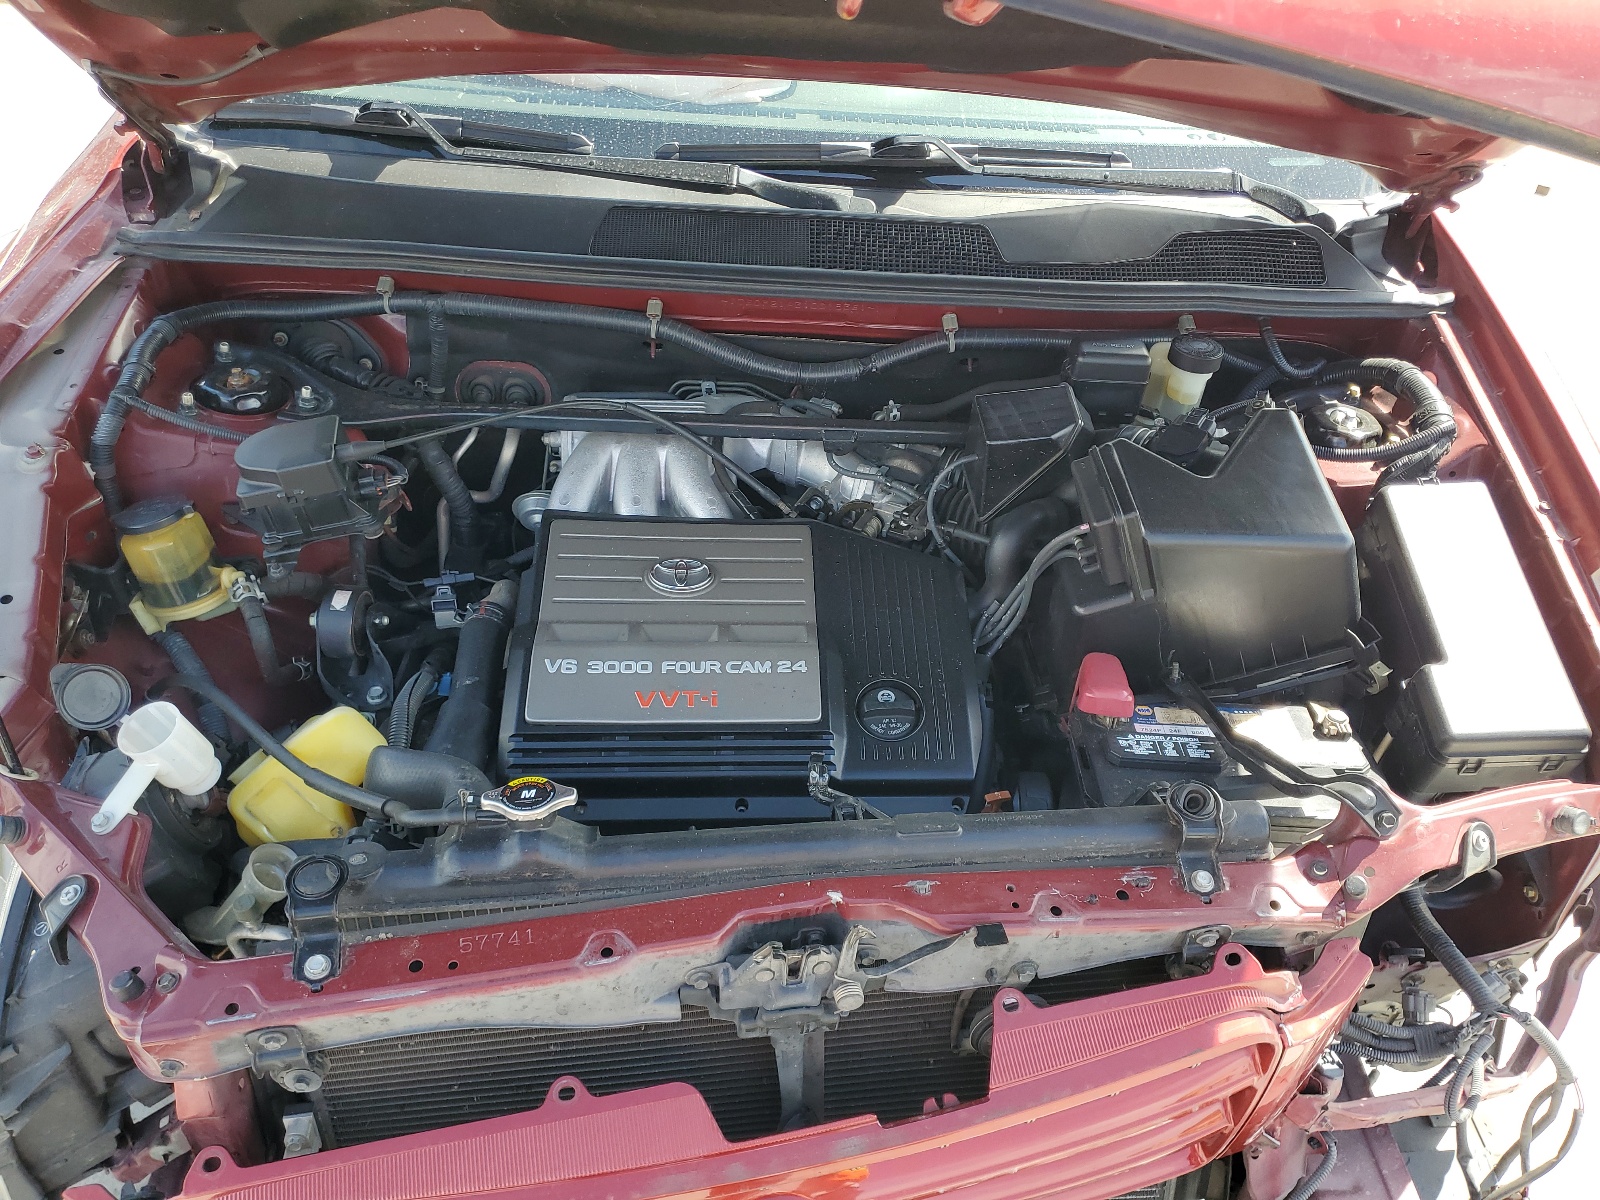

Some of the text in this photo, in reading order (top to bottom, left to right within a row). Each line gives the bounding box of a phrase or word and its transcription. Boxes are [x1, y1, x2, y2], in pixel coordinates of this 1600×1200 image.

[544, 658, 808, 674] V6 3000 FOUR CAM 24
[634, 690, 719, 709] VVT-i
[458, 928, 535, 953] 57741
